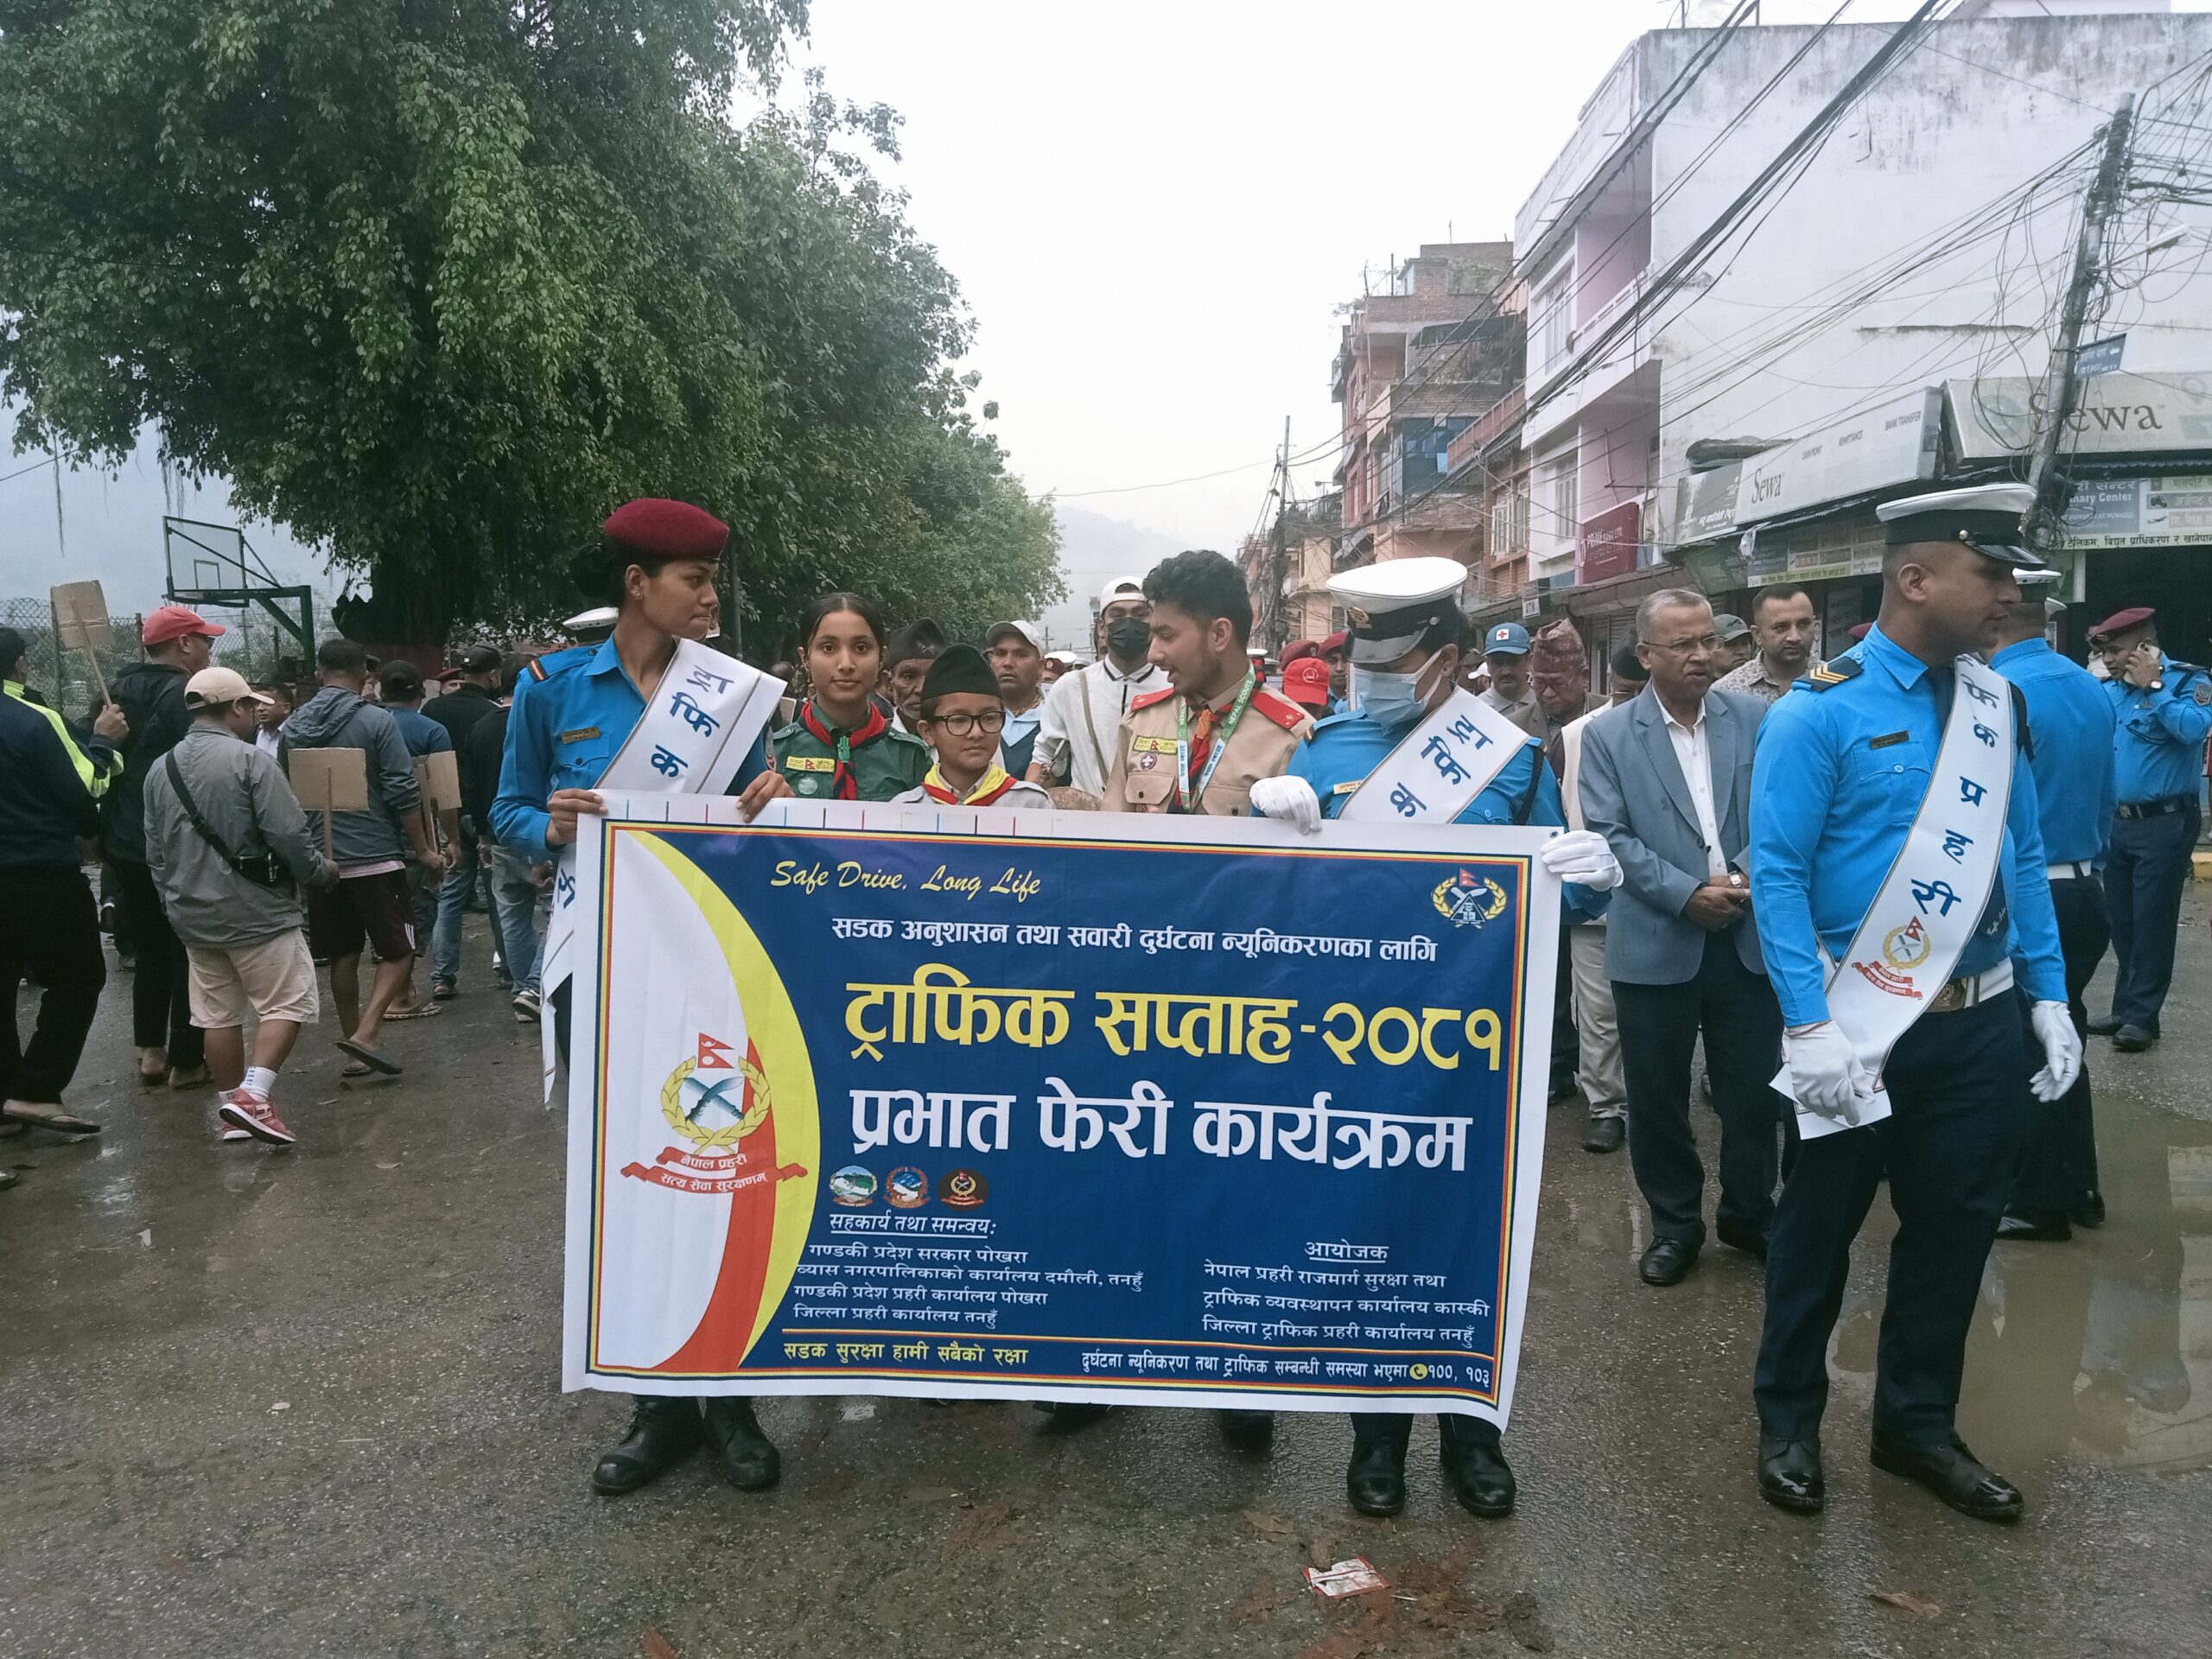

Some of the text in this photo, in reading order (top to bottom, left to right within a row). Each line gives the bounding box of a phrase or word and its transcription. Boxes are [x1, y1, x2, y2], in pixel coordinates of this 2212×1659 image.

[1751, 468, 1782, 504] Sewa
[2099, 493, 2133, 502] Center
[2130, 534, 2170, 546] प्राधिकरण
[1228, 680, 1253, 725] NEPAL SCOUTS
[771, 861, 1040, 902] Safe Drive, Long Life
[832, 918, 893, 938] सडक
[901, 921, 1009, 946] अनुशासन
[1017, 925, 1060, 944] तथा
[1068, 923, 1133, 948] सवारी
[1222, 928, 1372, 958] न्यूनिकरणका
[1380, 935, 1438, 961] लागि
[846, 963, 1501, 1071] ट्राफिक सप्ताह-२०८१
[849, 1077, 1473, 1171] प्रभात फेरी कार्यक्रम
[680, 1153, 747, 1170] नेपाल प्रहरी
[659, 1173, 687, 1189] सत्य
[690, 1179, 712, 1191] सेवा
[830, 1210, 892, 1231] सहकार्य
[894, 1217, 927, 1231] तथा
[809, 1242, 1028, 1263] गण्डकी प्रदेश सरकार पोखरा
[1304, 1239, 1389, 1260] आयोजक
[796, 1263, 1143, 1292] व्यास नगरपालिकाको कार्यालय दमौली, तनहुँ
[1204, 1259, 1446, 1292] नेपाल प्रहरी राजमार्ग सुरक्षा तथा
[794, 1282, 1048, 1305] गण्डकी प्रदेश प्रहरी कार्यालय पोखरा
[1203, 1287, 1490, 1317] ट्राफिक व्यवस्थापन कार्यालय कास्की
[793, 1303, 997, 1329] जिल्ला प्रहरी कार्यालय तनहुँ
[1202, 1314, 1474, 1348] जिल्ला ट्राफिक प्रहरी कार्यालय तनहुँ
[784, 1341, 1028, 1365] सडक सुरक्षा हामी सबैको रक्षा
[1128, 1350, 1190, 1373] न्यूनिकरण
[1195, 1357, 1219, 1370] तथा
[1224, 1354, 1269, 1376] ट्राफिक
[1274, 1357, 1319, 1376] सम्बन्धी
[1325, 1363, 1368, 1377] समस्या
[1374, 1364, 1408, 1382] भएमा
